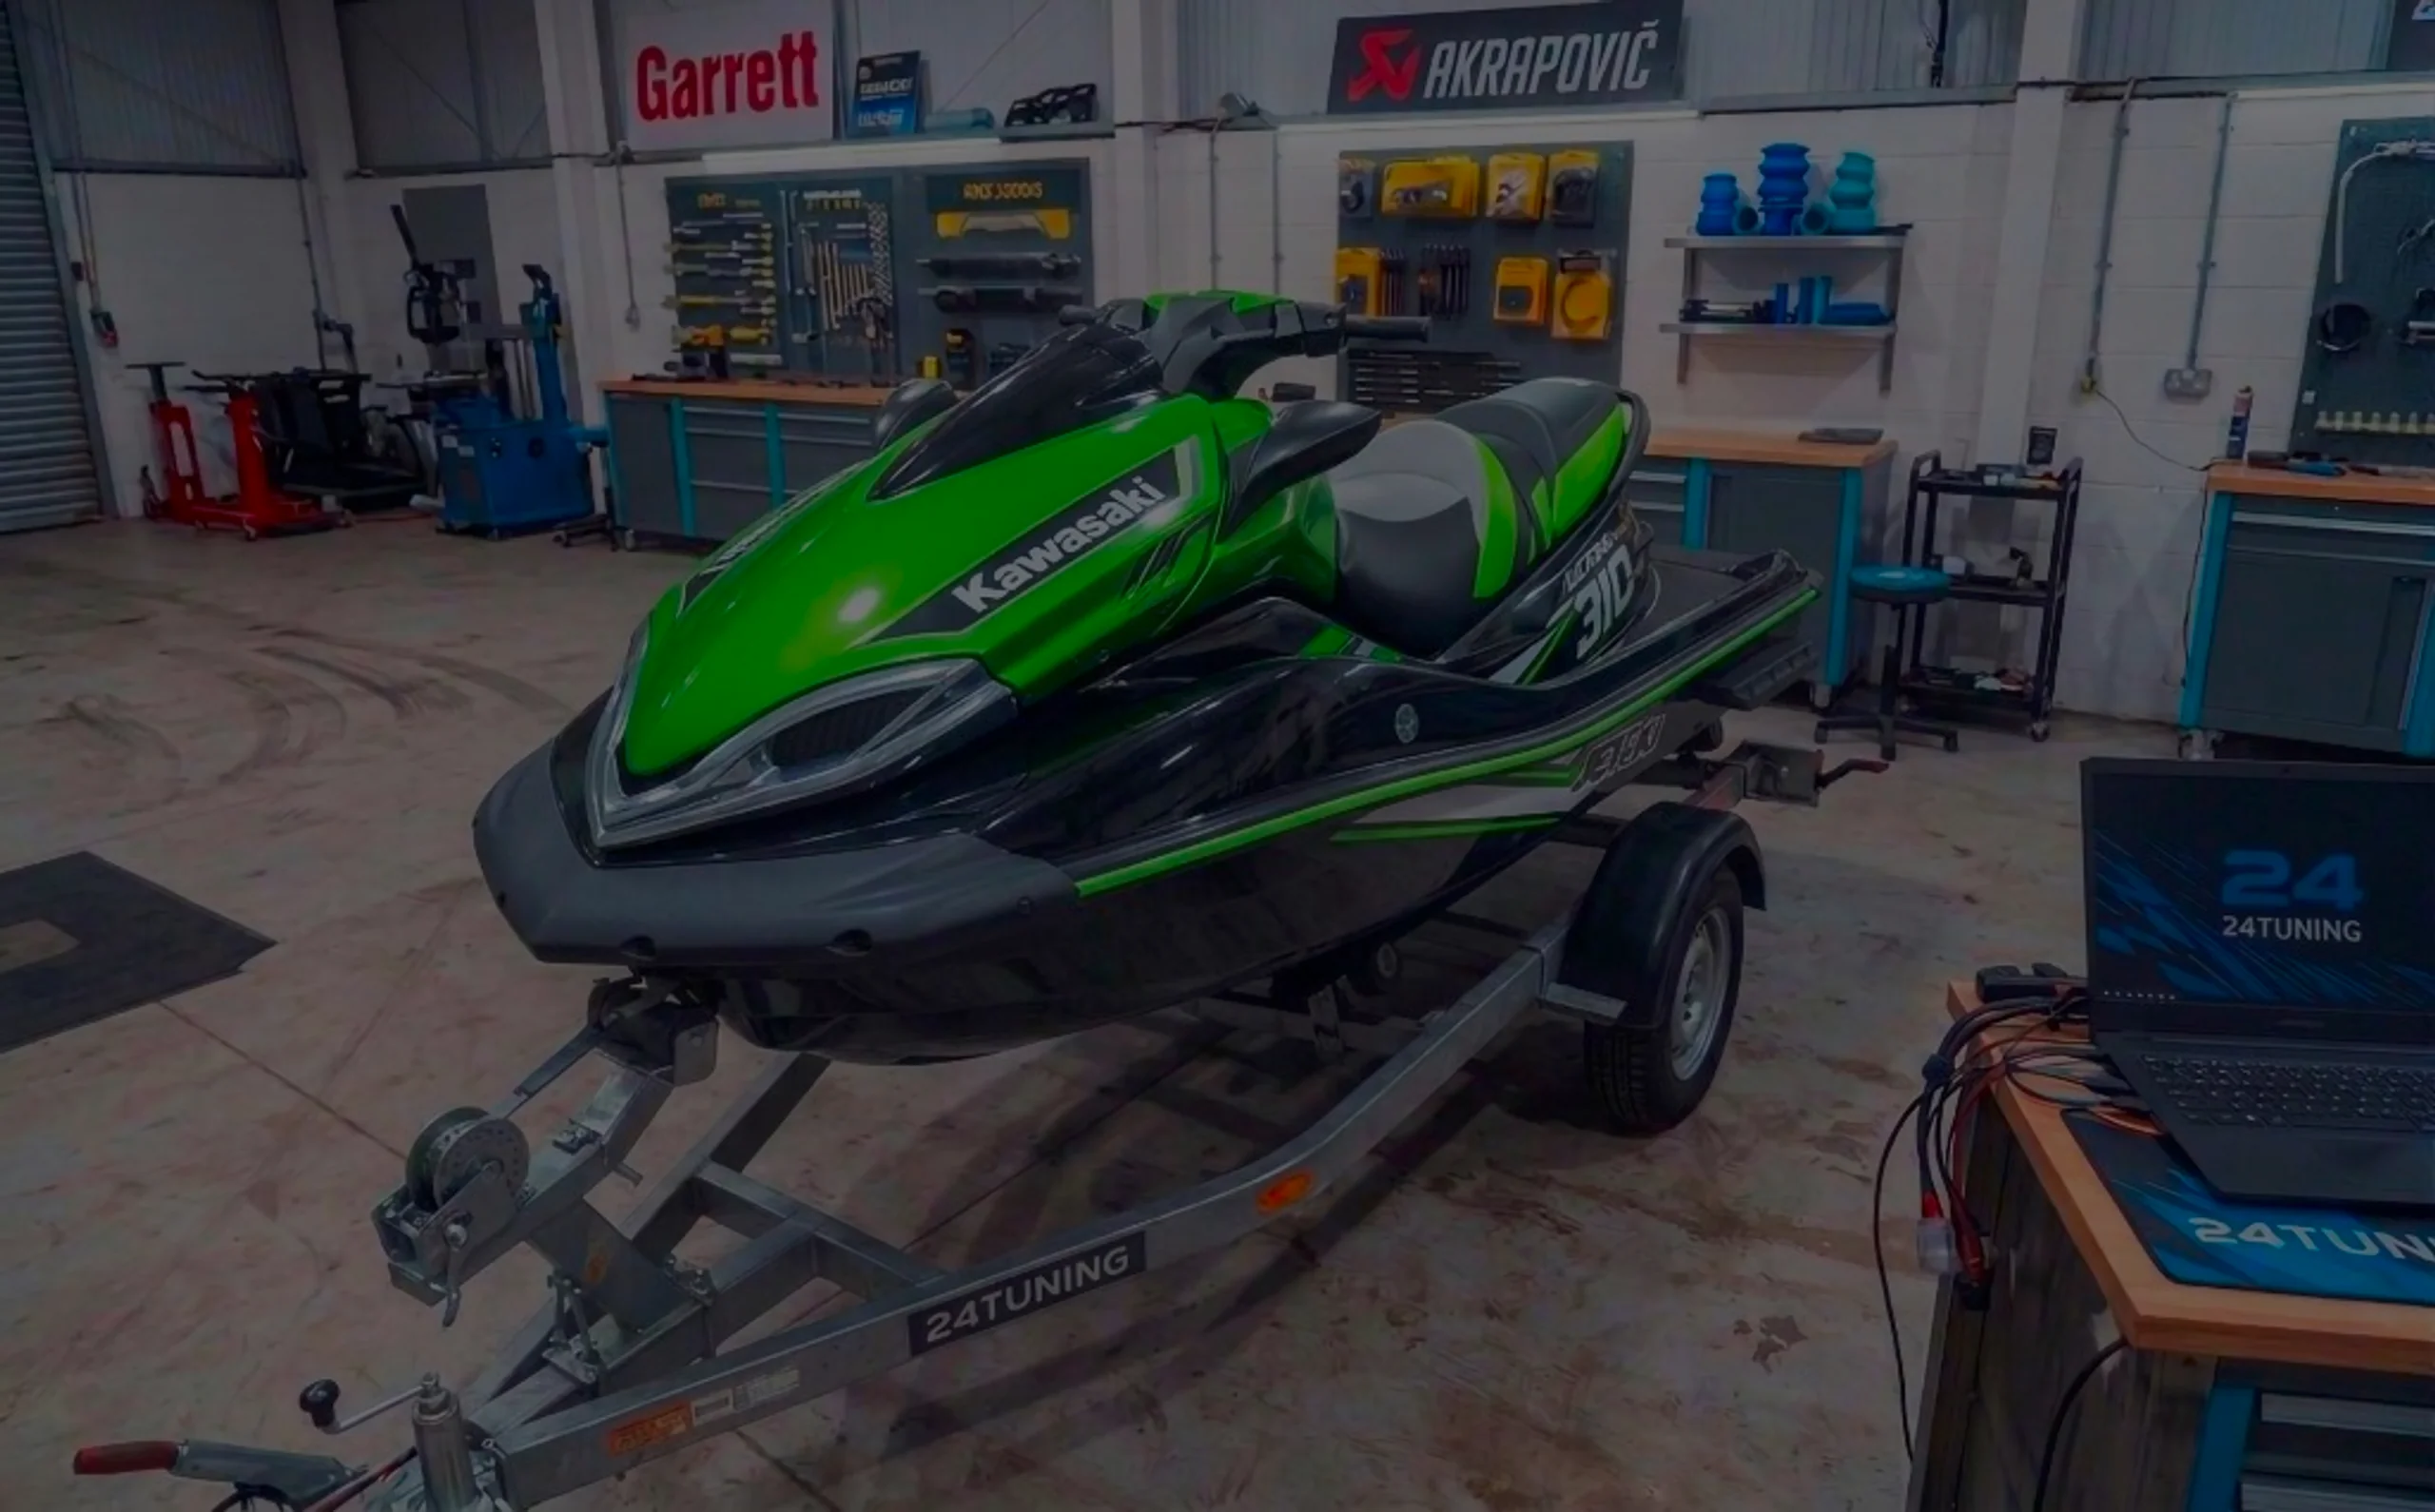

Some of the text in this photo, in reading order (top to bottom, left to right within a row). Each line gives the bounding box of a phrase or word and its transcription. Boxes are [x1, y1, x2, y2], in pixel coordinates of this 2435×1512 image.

[637, 30, 819, 122] Garrett
[1423, 18, 1661, 100] AKRAPOVIČ
[951, 475, 1166, 614] Kawasaki
[1573, 543, 1636, 661] 310
[2221, 849, 2367, 915] 24
[2222, 914, 2363, 943] 24TUNING
[926, 1245, 1130, 1344] 24TUNING
